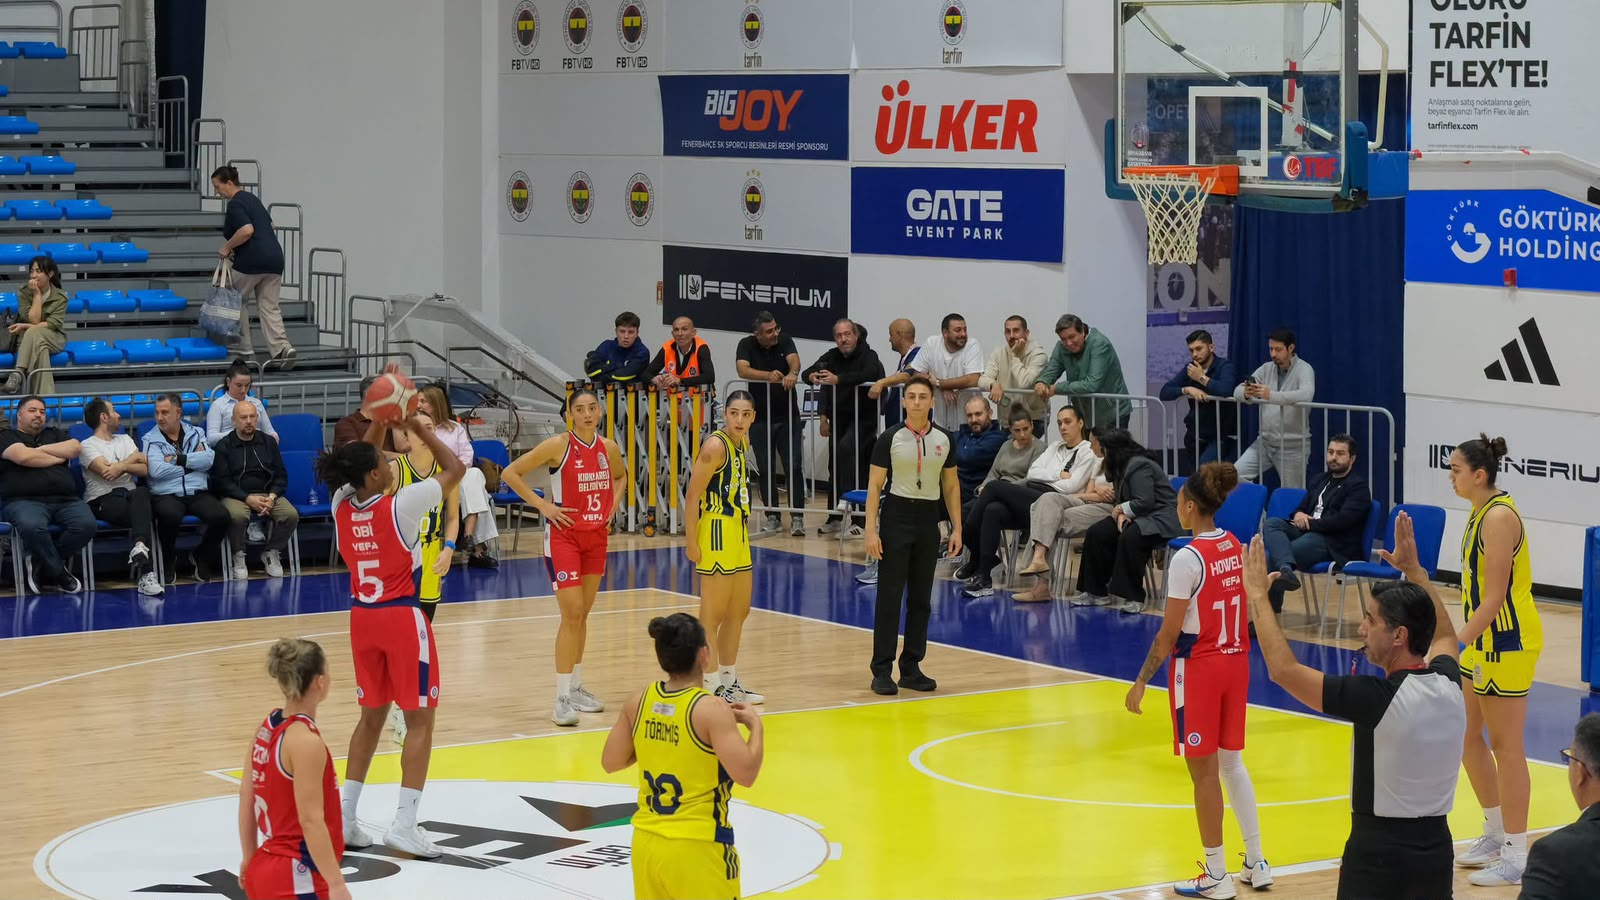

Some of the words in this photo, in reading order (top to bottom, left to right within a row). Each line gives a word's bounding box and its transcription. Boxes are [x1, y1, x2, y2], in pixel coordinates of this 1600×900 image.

[1429, 12, 1531, 49] TARFİN
[719, 89, 804, 131] JOY
[875, 79, 1038, 155] ÜLKER
[1428, 121, 1479, 130] tarfinflex.com
[1303, 156, 1338, 179] TBF
[906, 188, 1003, 222] GATE
[906, 225, 954, 238] EVENT
[963, 227, 1003, 240] PARK
[703, 280, 831, 308] FENERIUM
[586, 493, 602, 512] 15
[357, 559, 384, 603] 5
[1212, 594, 1241, 649] 11
